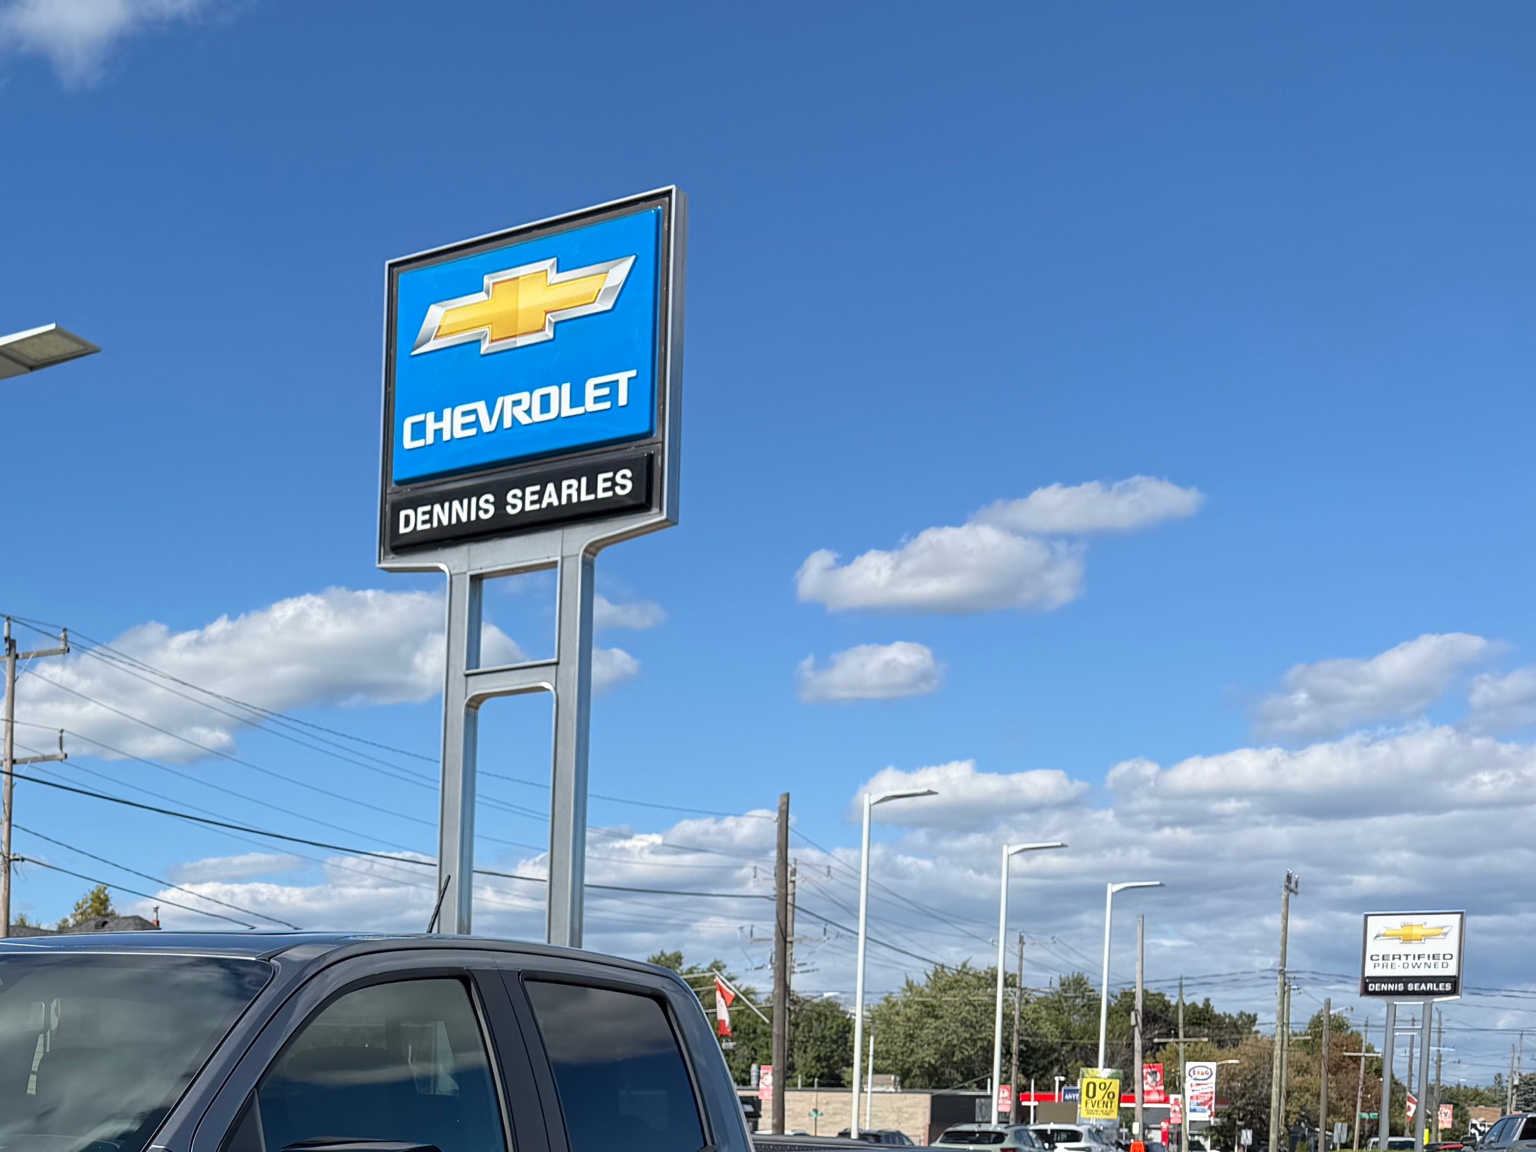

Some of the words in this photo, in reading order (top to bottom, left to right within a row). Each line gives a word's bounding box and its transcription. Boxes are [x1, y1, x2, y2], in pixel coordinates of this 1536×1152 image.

[402, 369, 637, 450] CHEVROLET
[399, 493, 495, 534] DENNIS
[505, 468, 633, 516] SEARLES
[1370, 953, 1453, 961] CERTIFIED
[1373, 961, 1449, 970] PRE-OWNED
[1368, 983, 1404, 991] DENNIS
[1407, 982, 1452, 991] SEARLES
[1085, 1081, 1115, 1100] 0%
[1085, 1100, 1114, 1109] EVENT
